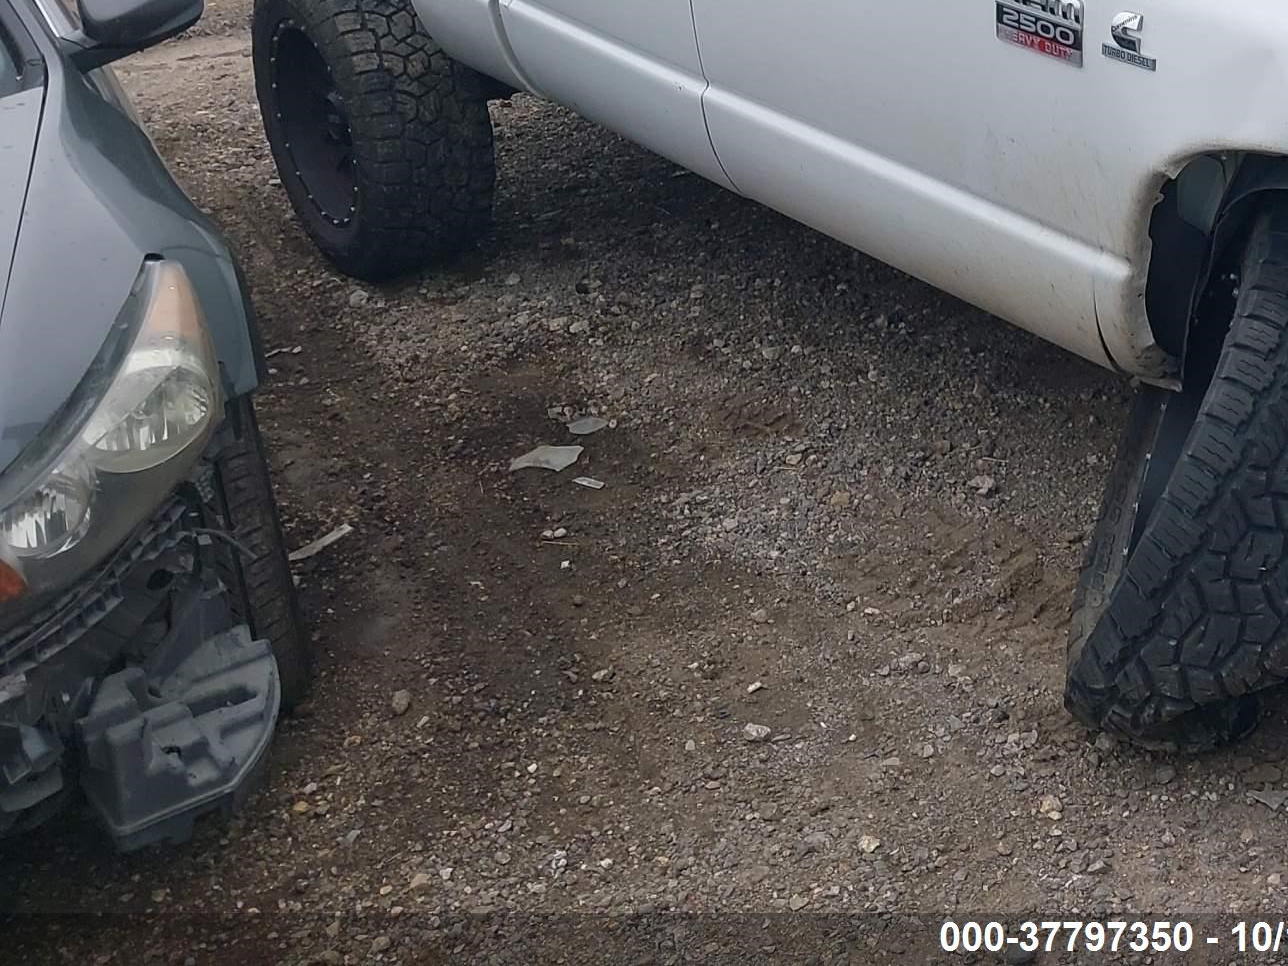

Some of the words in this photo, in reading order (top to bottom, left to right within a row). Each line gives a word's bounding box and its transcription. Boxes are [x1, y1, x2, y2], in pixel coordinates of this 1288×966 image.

[1002, 7, 1075, 45] 2500
[1044, 42, 1073, 61] DUTY
[1103, 45, 1126, 60] TURBO
[1127, 52, 1151, 68] DIESEL
